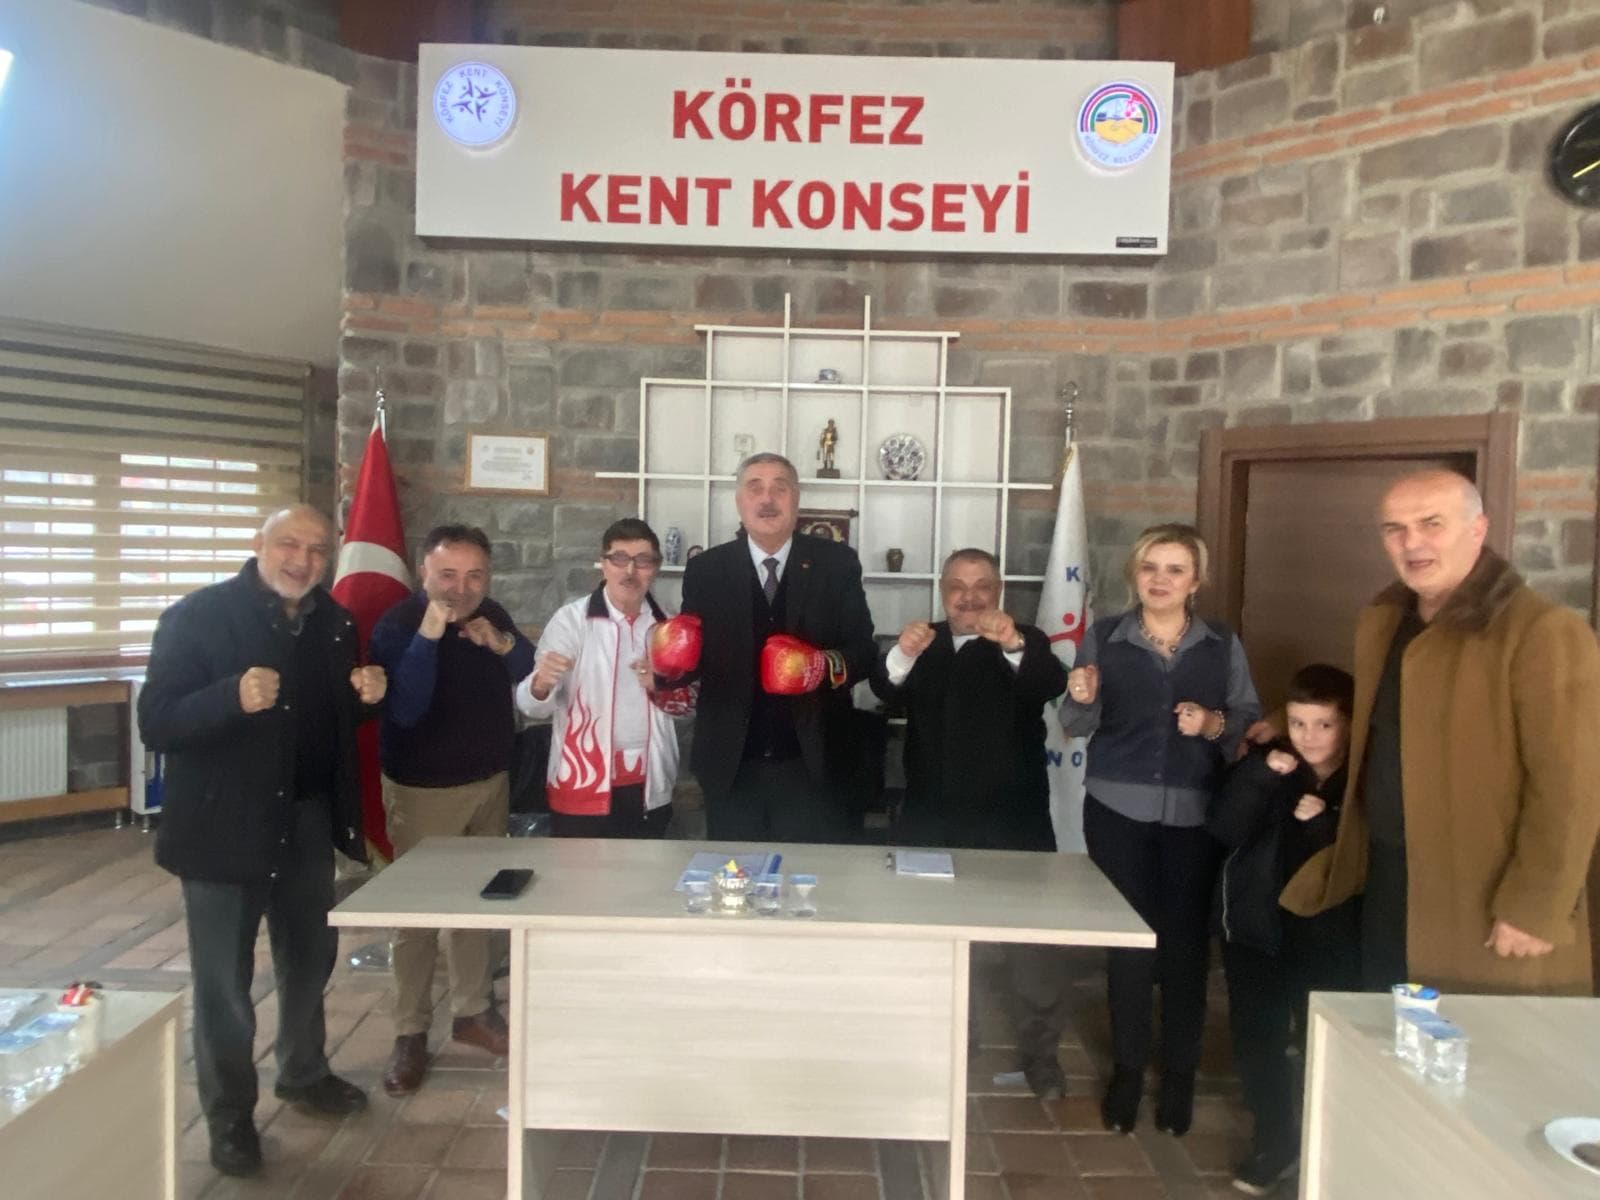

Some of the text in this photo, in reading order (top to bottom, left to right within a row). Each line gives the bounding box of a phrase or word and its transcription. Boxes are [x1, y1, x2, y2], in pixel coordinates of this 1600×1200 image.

[460, 67, 486, 78] KENT
[673, 78, 925, 145] KÖRFEZ
[561, 169, 1030, 233] KENT KONSEYİ
